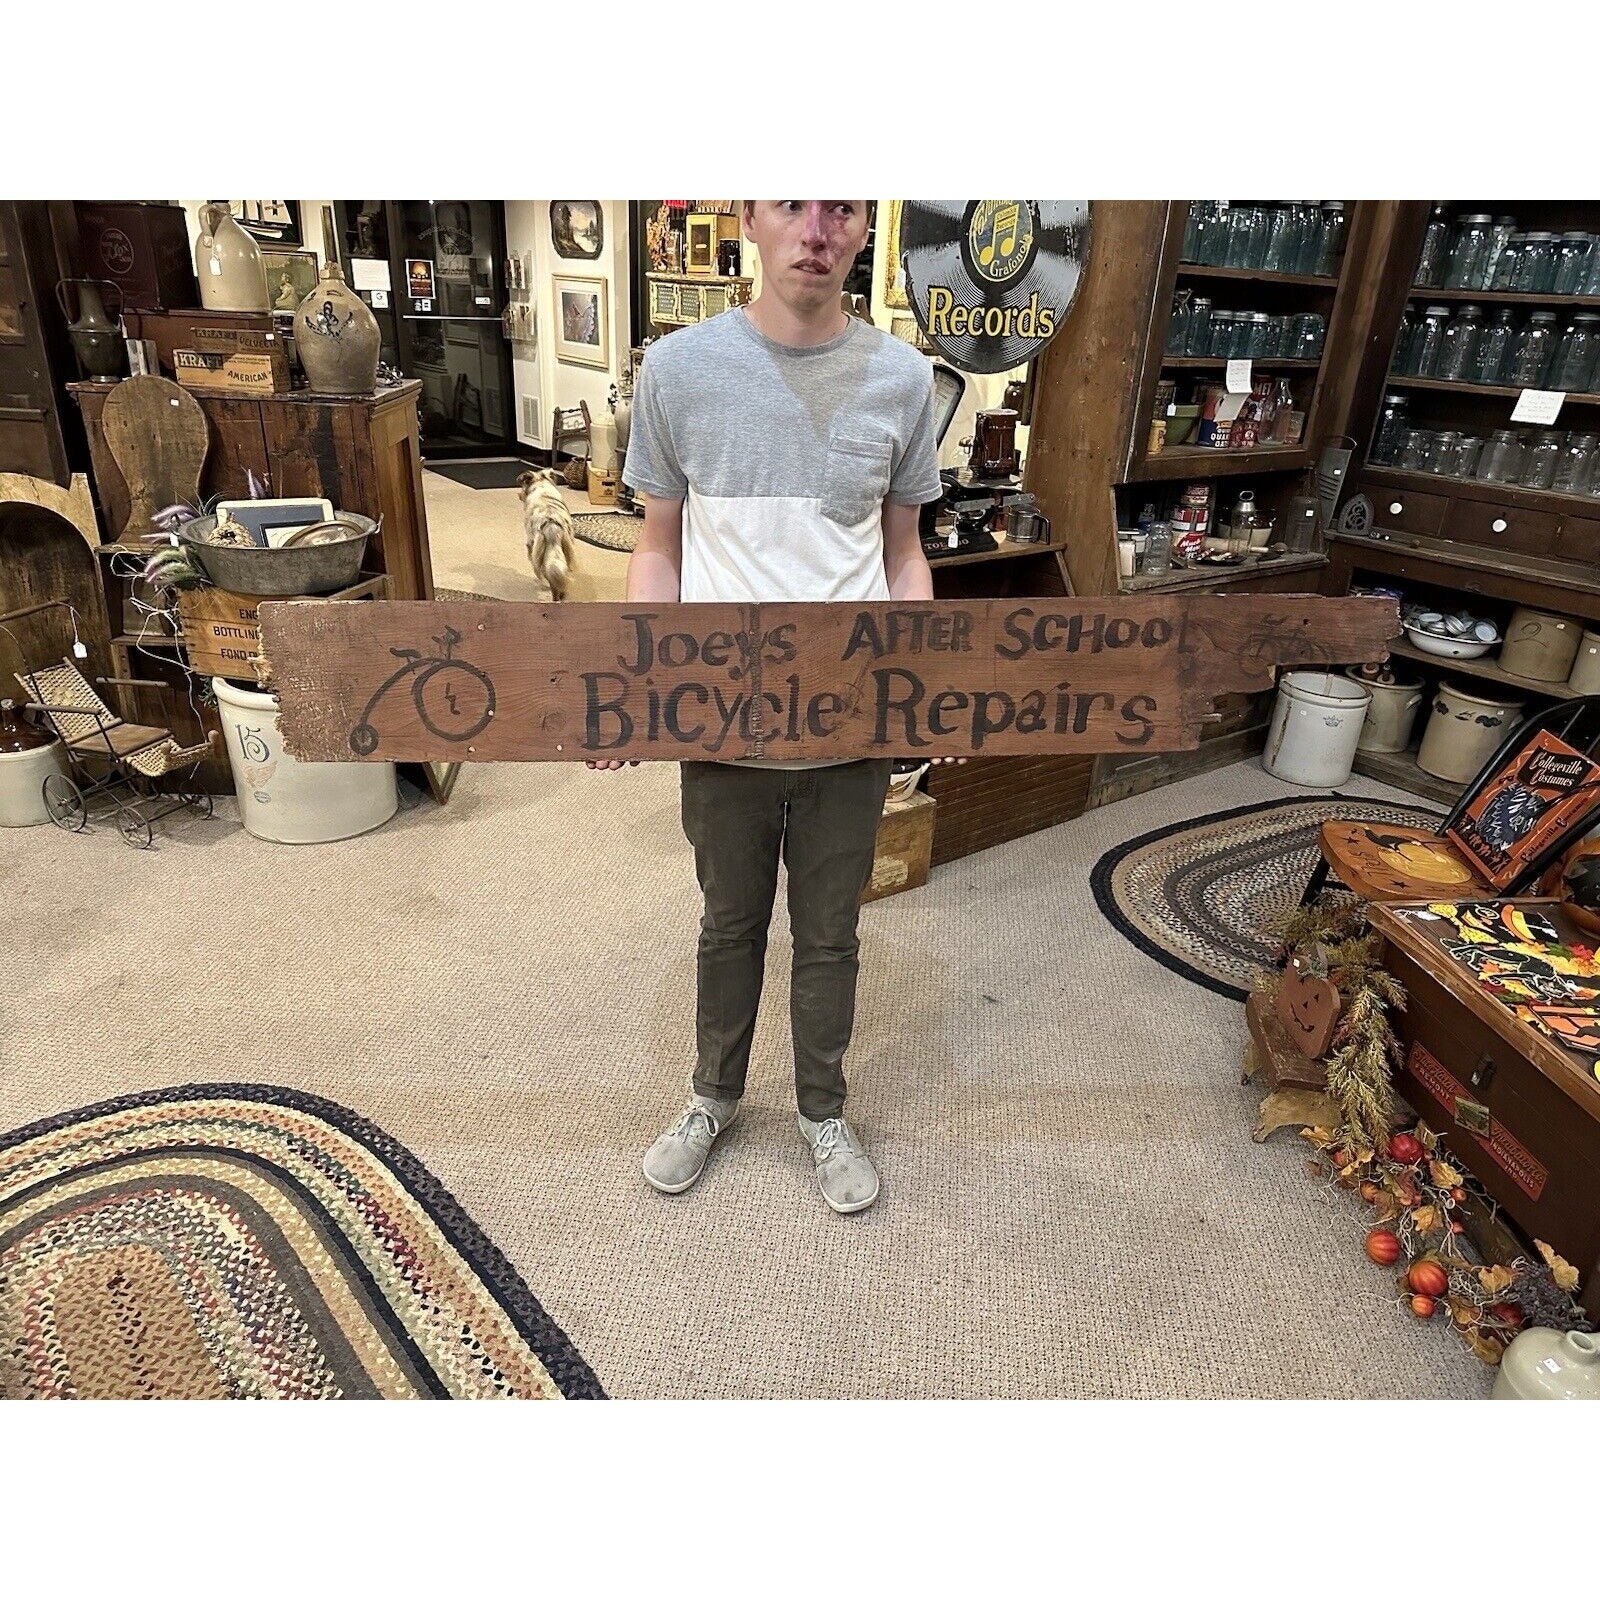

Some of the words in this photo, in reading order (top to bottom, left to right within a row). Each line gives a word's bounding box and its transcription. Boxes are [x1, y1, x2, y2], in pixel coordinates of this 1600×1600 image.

[989, 234, 1032, 278] Grafonol
[927, 287, 1055, 338] Records
[179, 353, 221, 369] KRAFT
[227, 370, 268, 383] AMERICAN
[924, 539, 969, 550] TOLO
[240, 609, 258, 620] ENG
[220, 648, 247, 660] FOND
[616, 612, 798, 681] Joeys
[841, 609, 974, 661] AFTER
[993, 607, 1191, 661] SCHOOL
[580, 671, 845, 752] Bicycle
[871, 667, 1158, 750] Repairs
[235, 723, 270, 763] 15
[1528, 751, 1583, 775] Collegeville
[1529, 768, 1576, 787] Costumes
